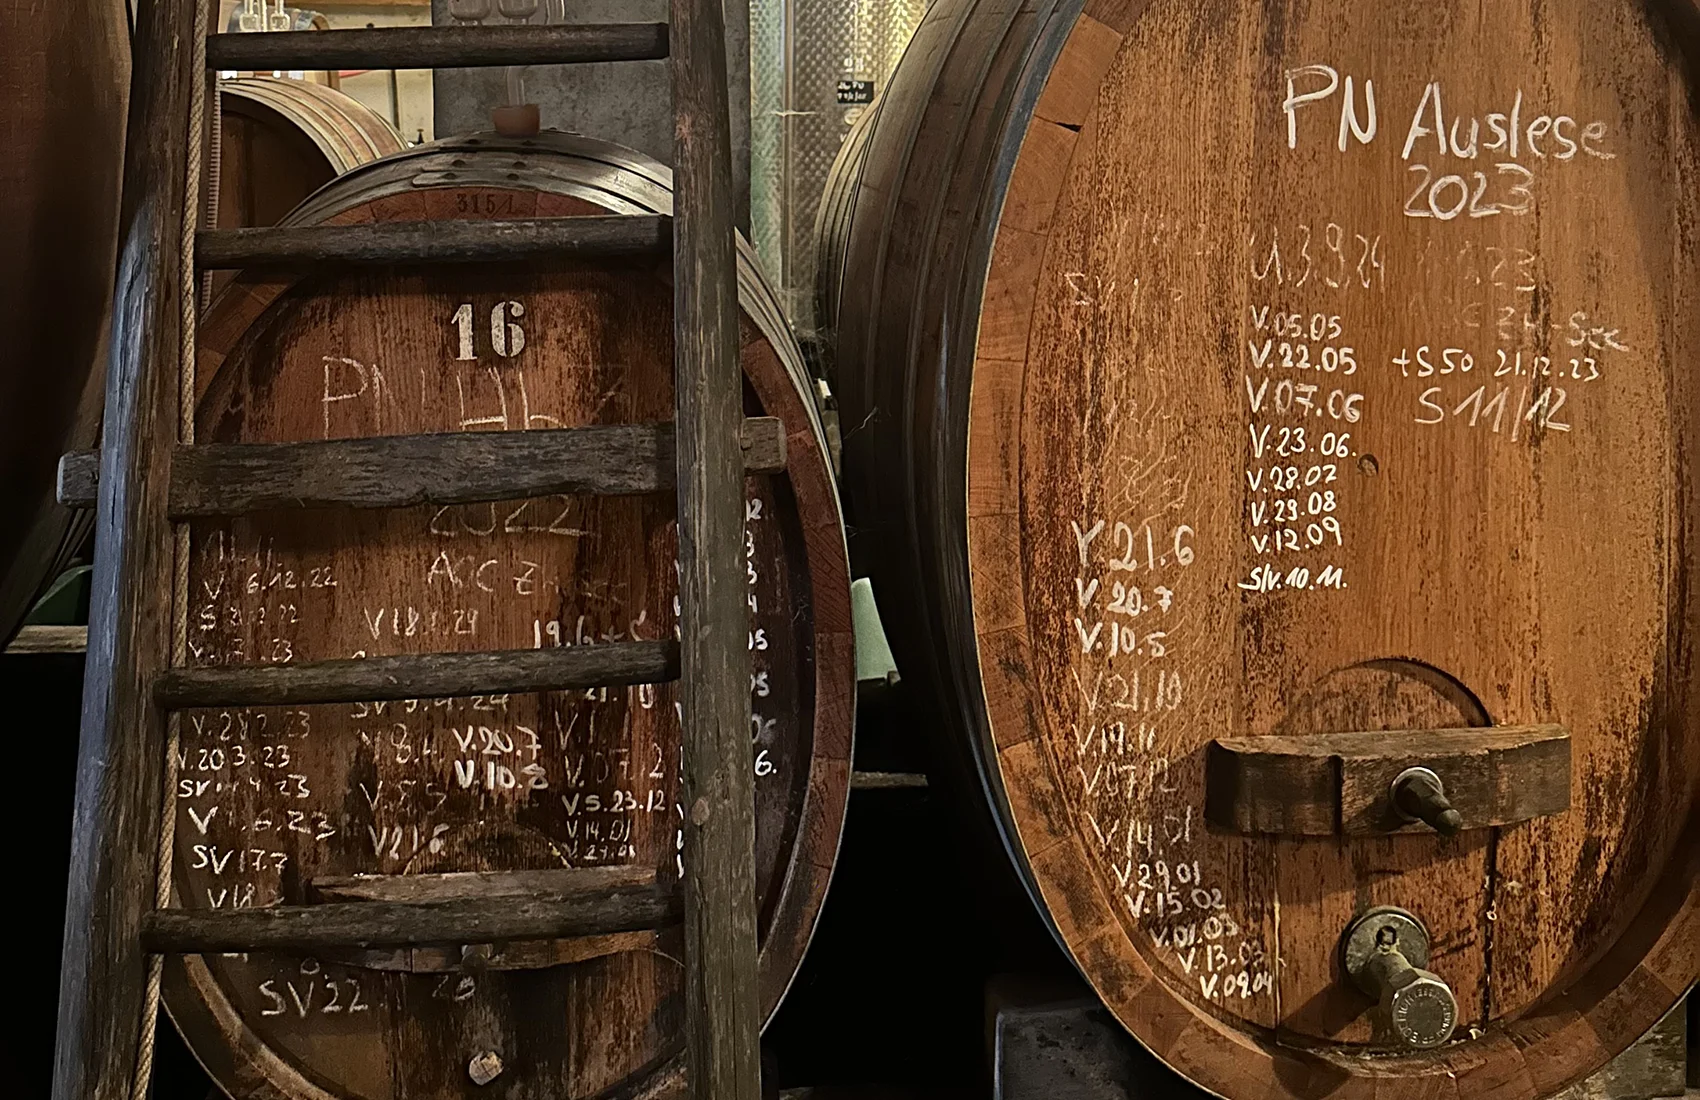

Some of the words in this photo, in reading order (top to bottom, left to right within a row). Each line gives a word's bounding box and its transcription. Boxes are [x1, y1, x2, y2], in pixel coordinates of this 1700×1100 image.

[1284, 64, 1377, 152] PN
[1402, 79, 1616, 160] Auslese
[1404, 162, 1535, 220] 2023
[451, 301, 526, 361] 16
